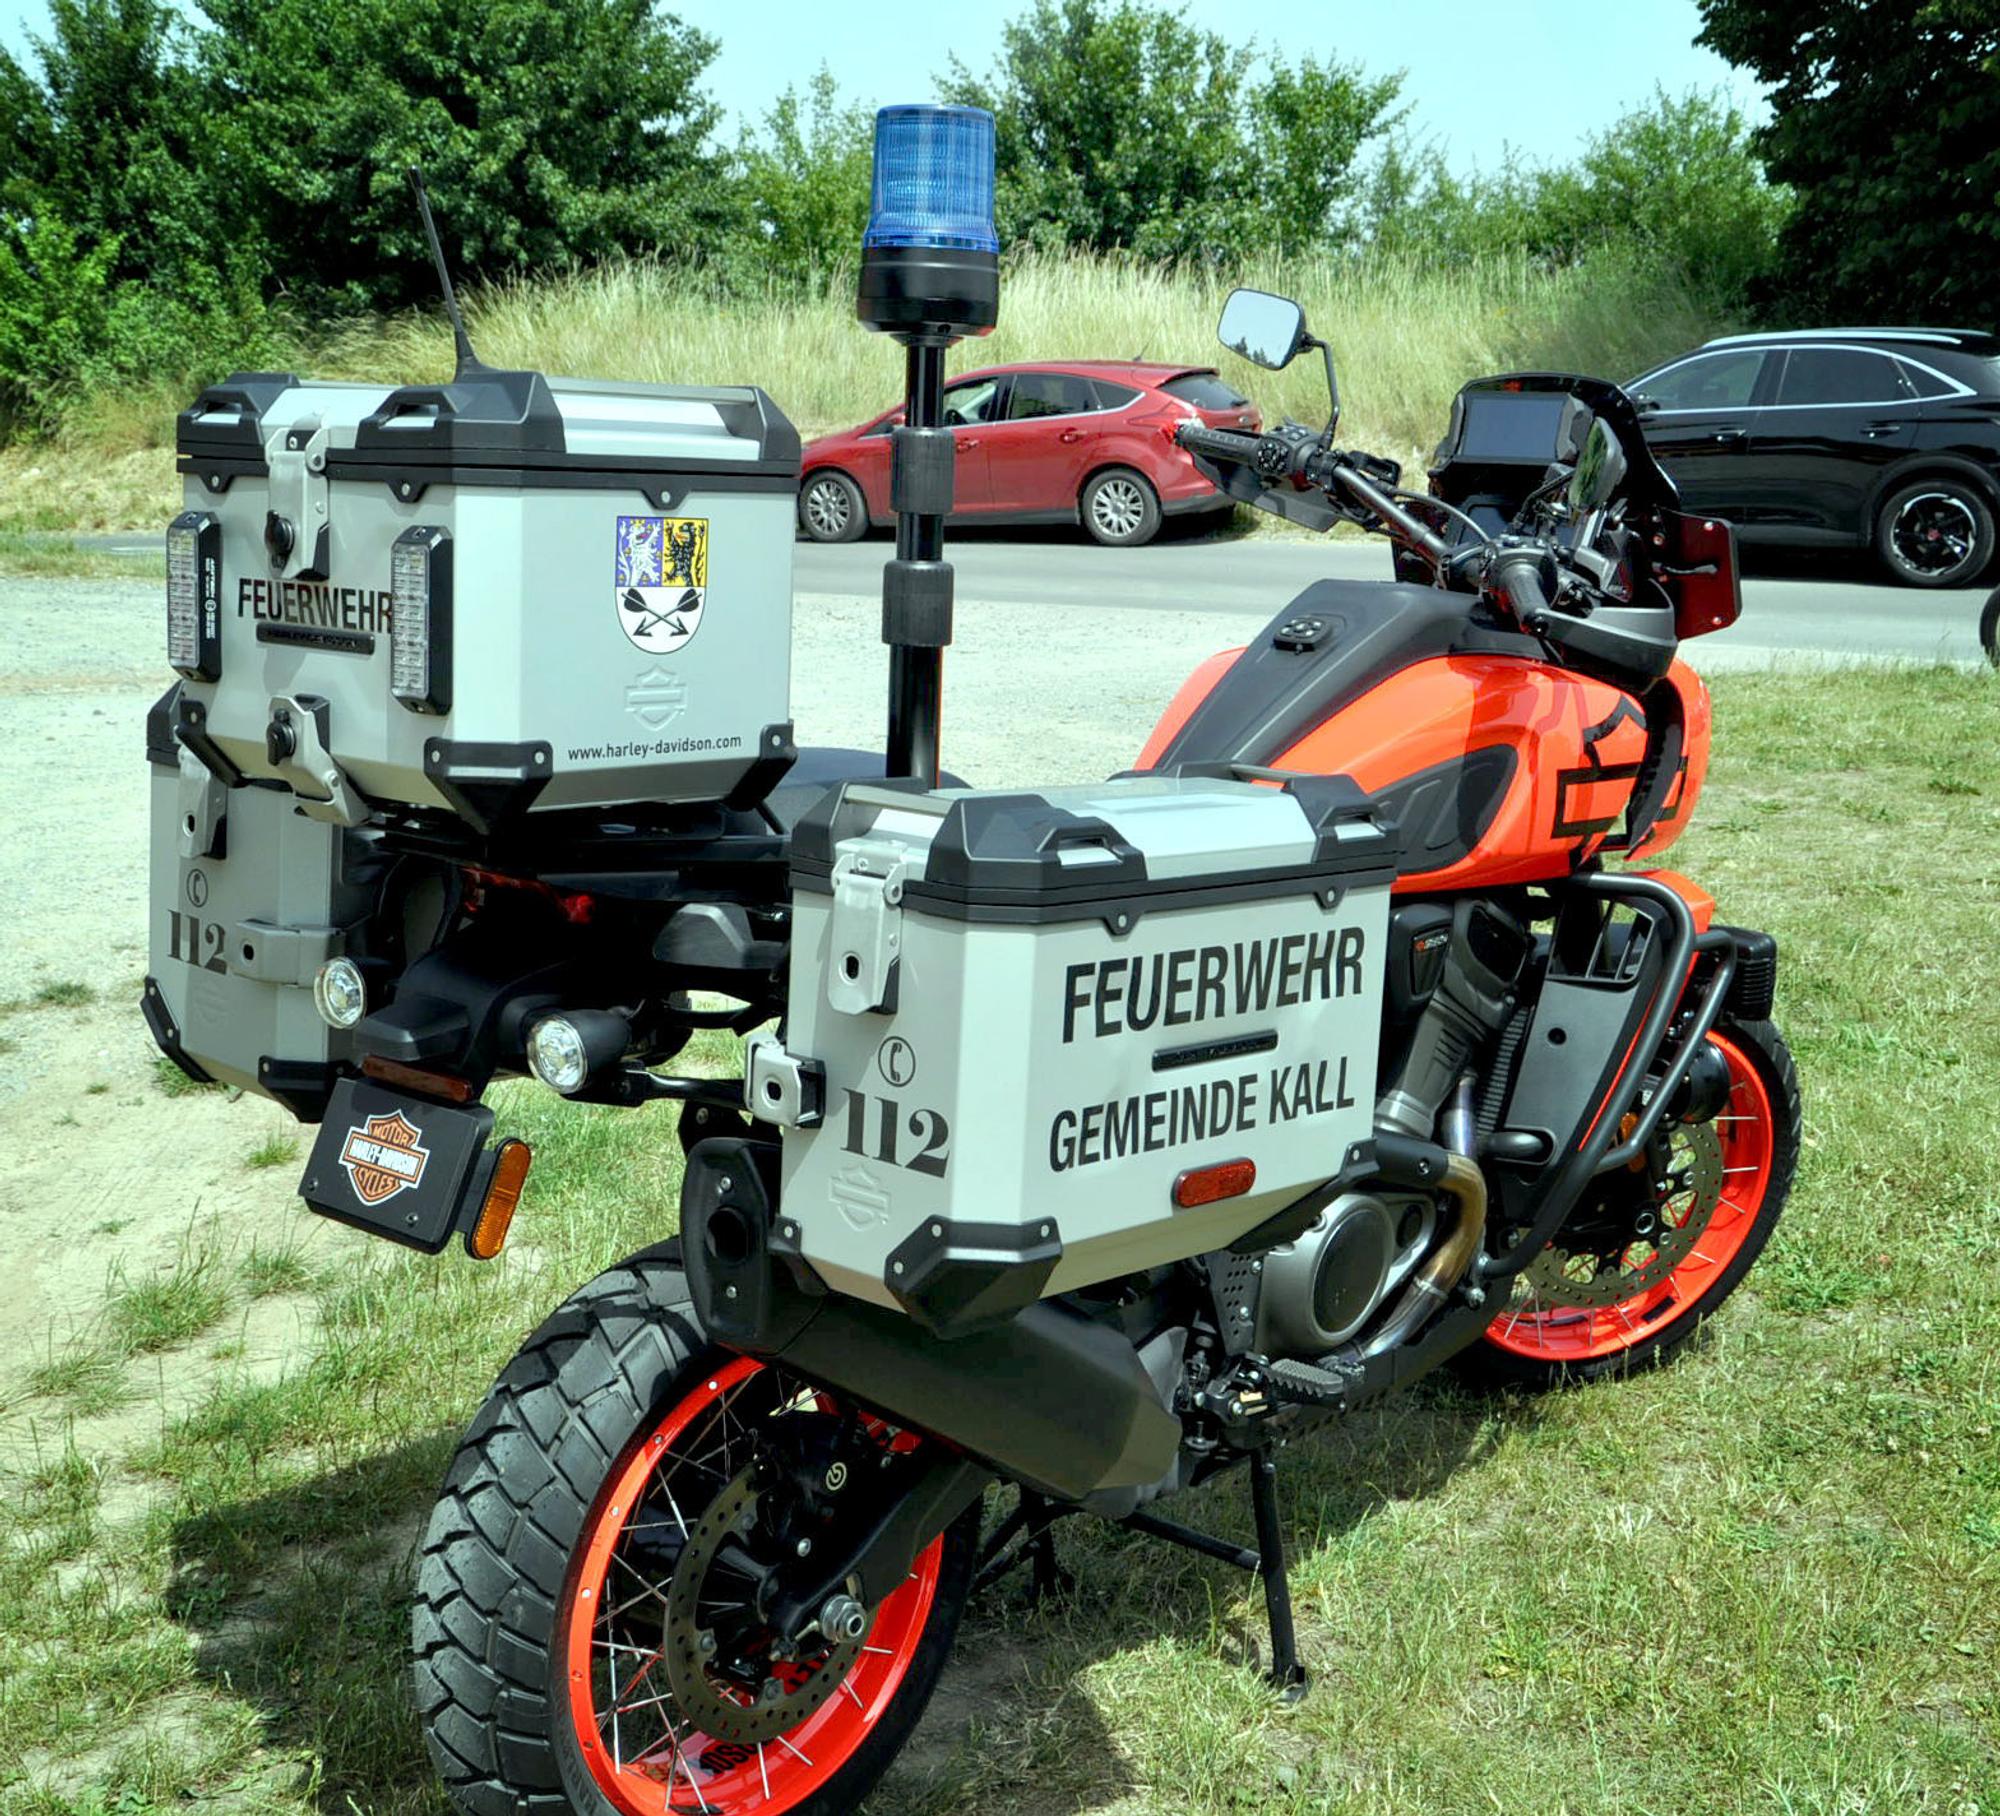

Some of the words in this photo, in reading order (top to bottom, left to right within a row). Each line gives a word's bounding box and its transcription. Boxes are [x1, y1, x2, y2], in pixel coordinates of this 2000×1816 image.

[238, 578, 393, 634] FEUERWEHR
[567, 735, 742, 760] www.harley-davidson.com
[167, 909, 228, 975] 112
[1062, 926, 1365, 1043] FEUERWEHR
[373, 1121, 409, 1147] MOTOR
[840, 1087, 950, 1179] 112
[1050, 1073, 1258, 1172] GEMEINDE
[1268, 1056, 1355, 1124] KALL
[359, 1166, 394, 1195] CYCLES
